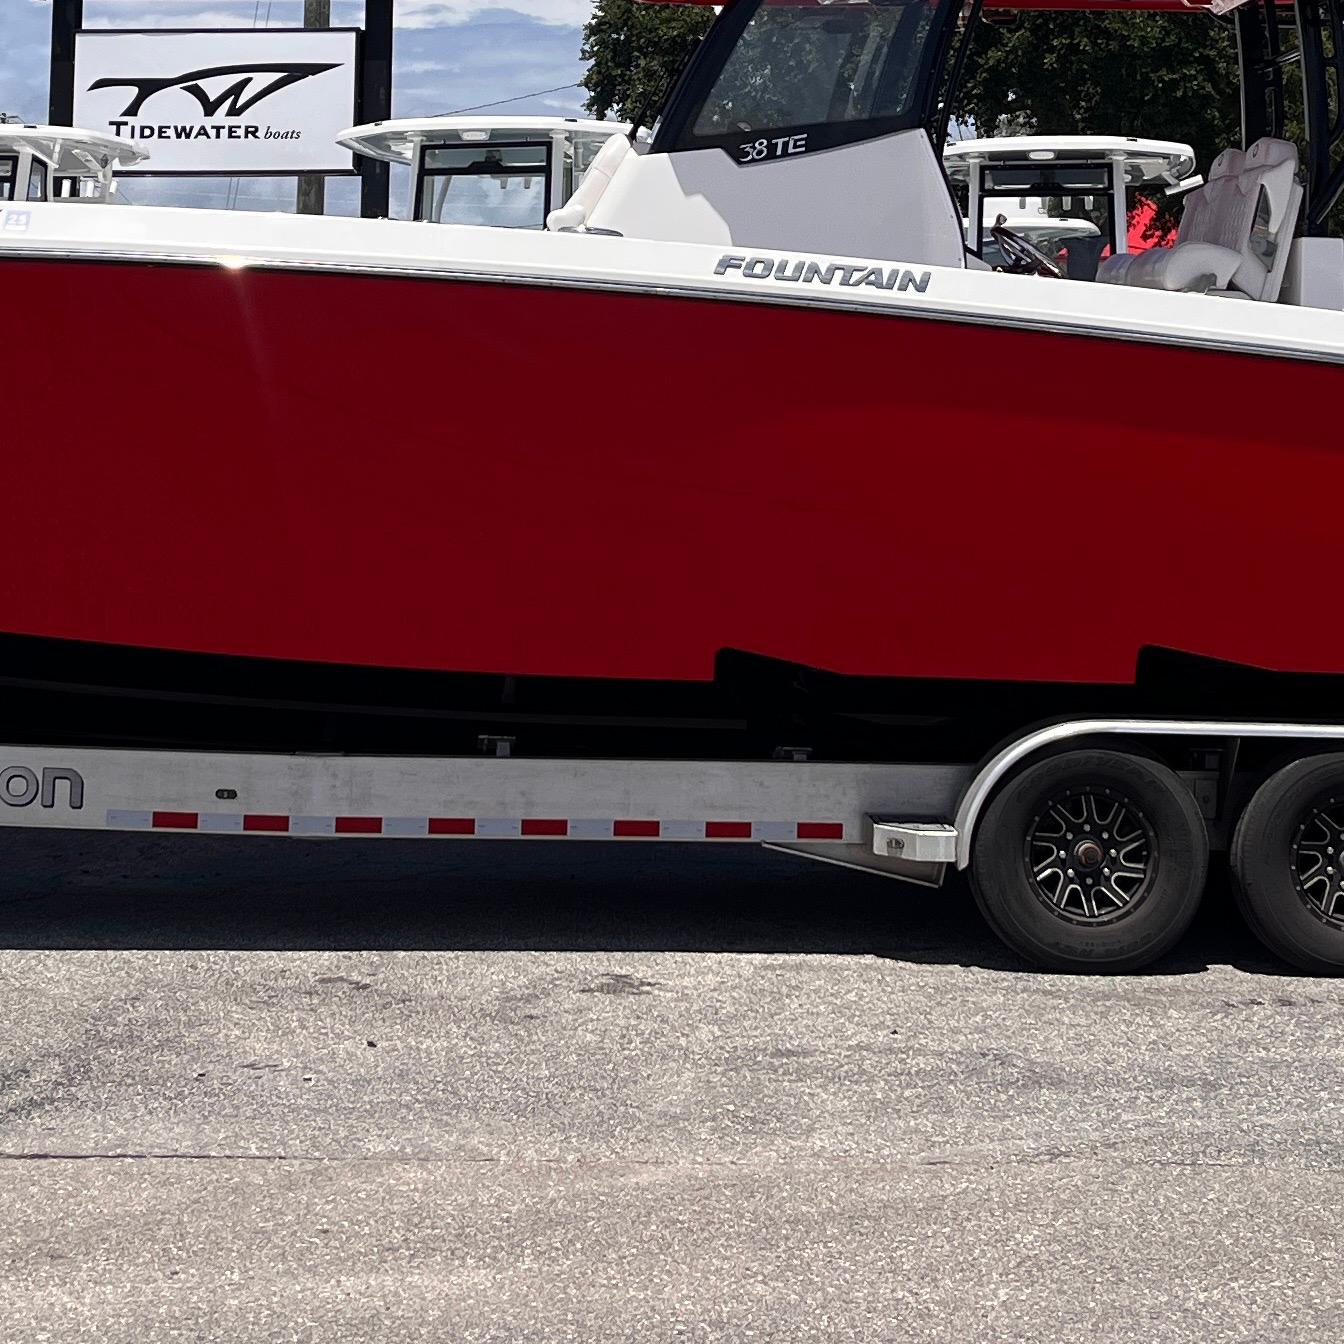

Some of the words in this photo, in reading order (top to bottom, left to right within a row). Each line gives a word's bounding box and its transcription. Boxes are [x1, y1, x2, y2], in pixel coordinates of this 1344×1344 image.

[108, 120, 261, 141] TIDEWATER
[263, 127, 302, 141] boats
[738, 138, 768, 162] 38
[771, 133, 808, 157] TE
[713, 255, 932, 293] FOUNTAIN
